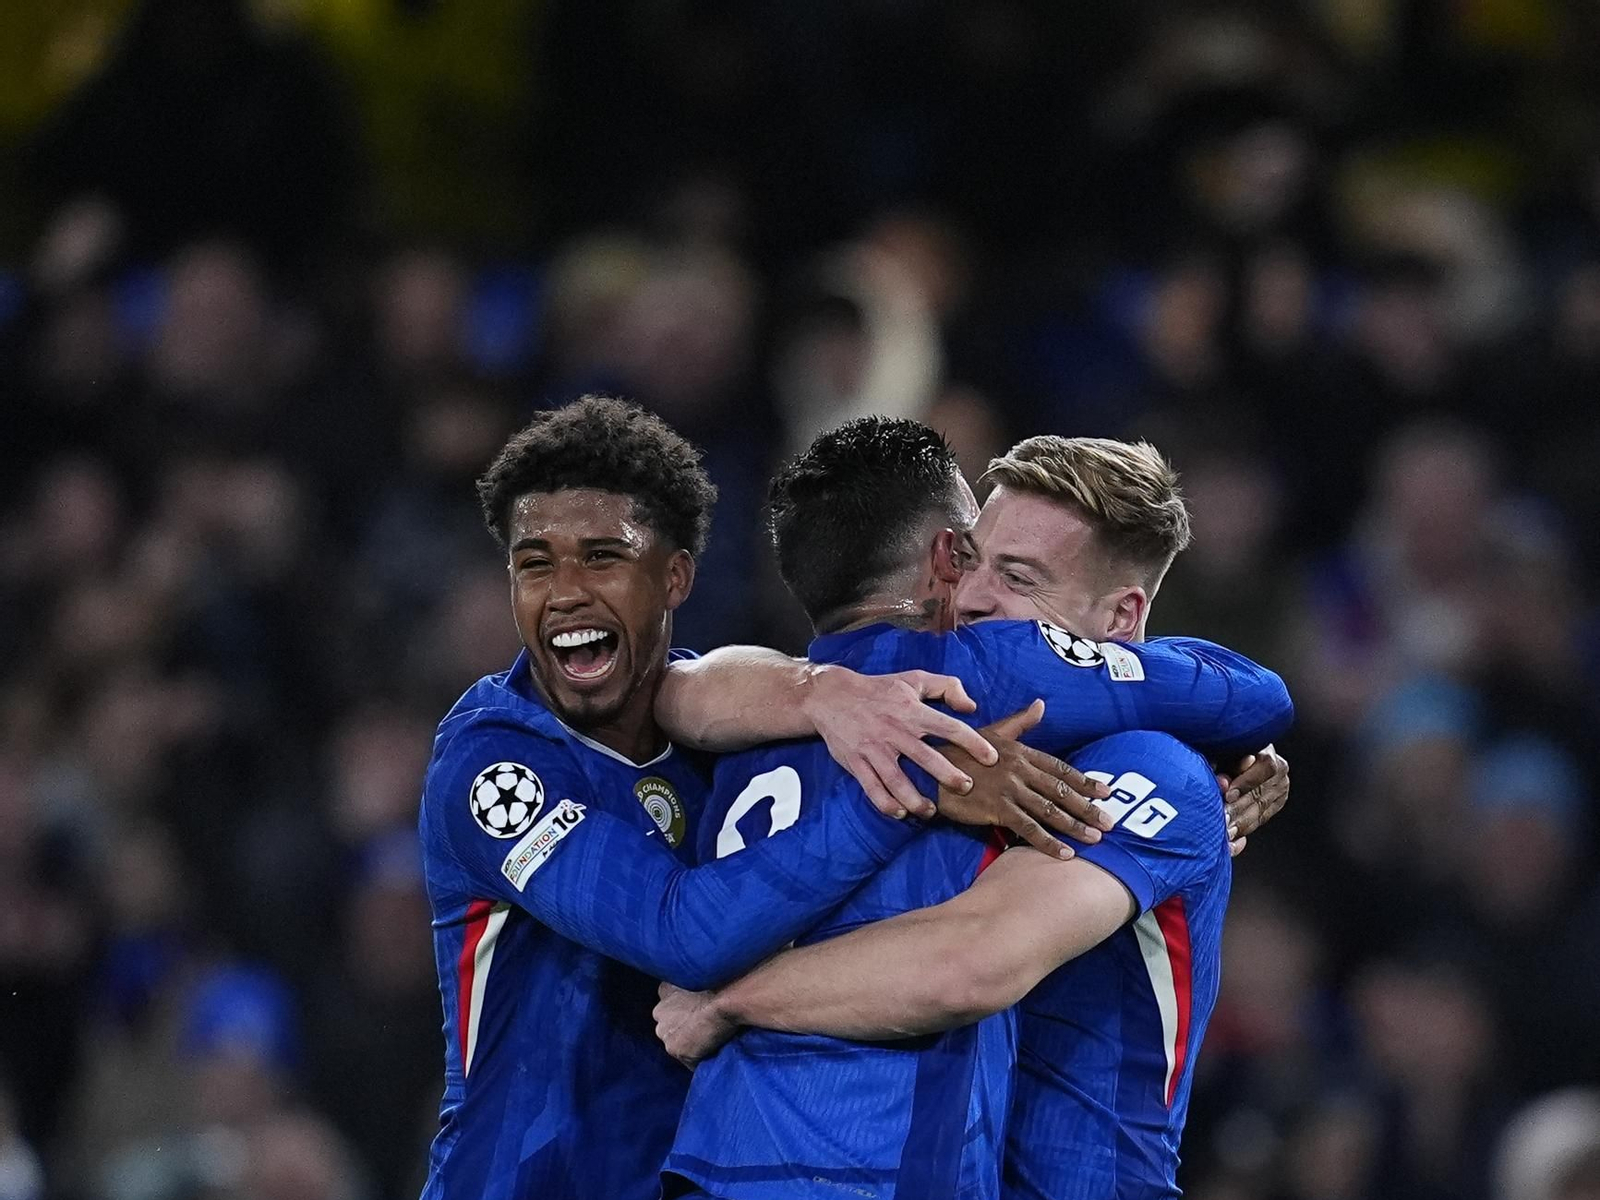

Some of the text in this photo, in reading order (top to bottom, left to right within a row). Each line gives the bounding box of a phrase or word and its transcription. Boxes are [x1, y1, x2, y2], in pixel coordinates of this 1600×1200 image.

[642, 783, 681, 819] CHAMPIONS
[1083, 770, 1179, 838] PT
[509, 827, 558, 883] FOUNDATION
